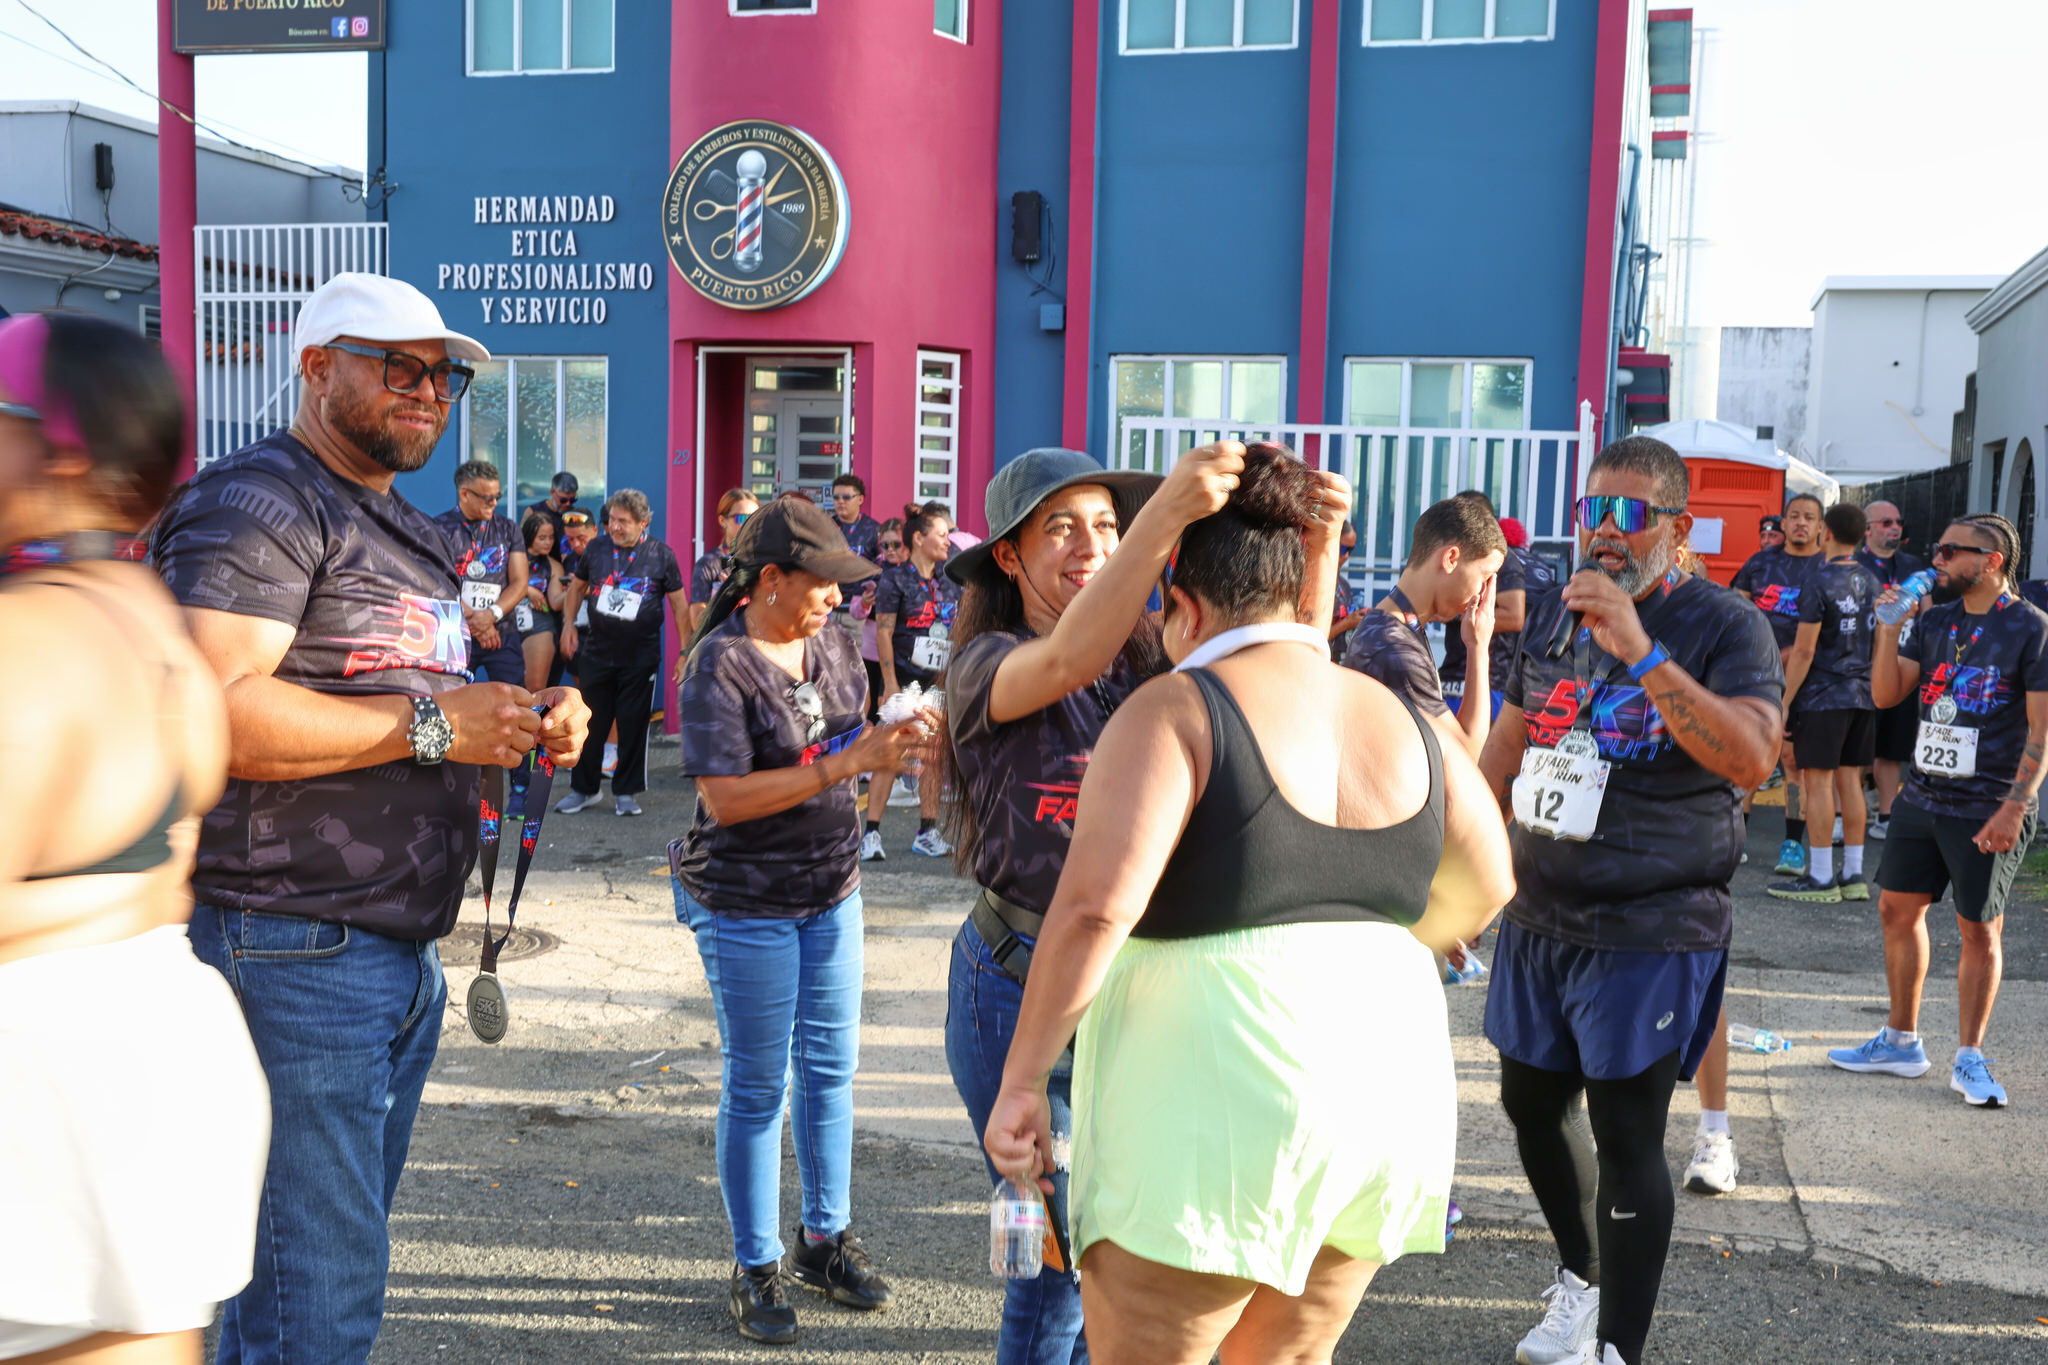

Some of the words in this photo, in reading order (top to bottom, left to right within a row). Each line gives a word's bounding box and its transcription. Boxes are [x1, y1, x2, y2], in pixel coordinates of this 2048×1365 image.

[206, 0, 227, 11] DE
[234, 0, 298, 10] PUERTO
[669, 175, 687, 225] COLEGIO
[684, 161, 697, 175] DE
[694, 130, 742, 162] BARBEROS
[744, 128, 751, 138] Y
[752, 128, 804, 157] ESTILISTAS
[800, 153, 815, 168] EN
[474, 195, 616, 224] HERMANDAD
[781, 203, 806, 214] 1989
[511, 229, 578, 257] ETICA
[438, 262, 654, 290] PROFESIONALISMO
[690, 266, 758, 301] PUERTO
[763, 269, 804, 299] RICO
[481, 297, 494, 324] Y
[501, 297, 607, 324] SERVICIO
[673, 449, 689, 465] 29
[396, 592, 468, 664] 5K
[1534, 679, 1646, 737] 5K
[1923, 745, 1958, 769] 223
[1554, 769, 1583, 785] RUN
[1035, 796, 1078, 823] FA
[1533, 786, 1565, 823] 12
